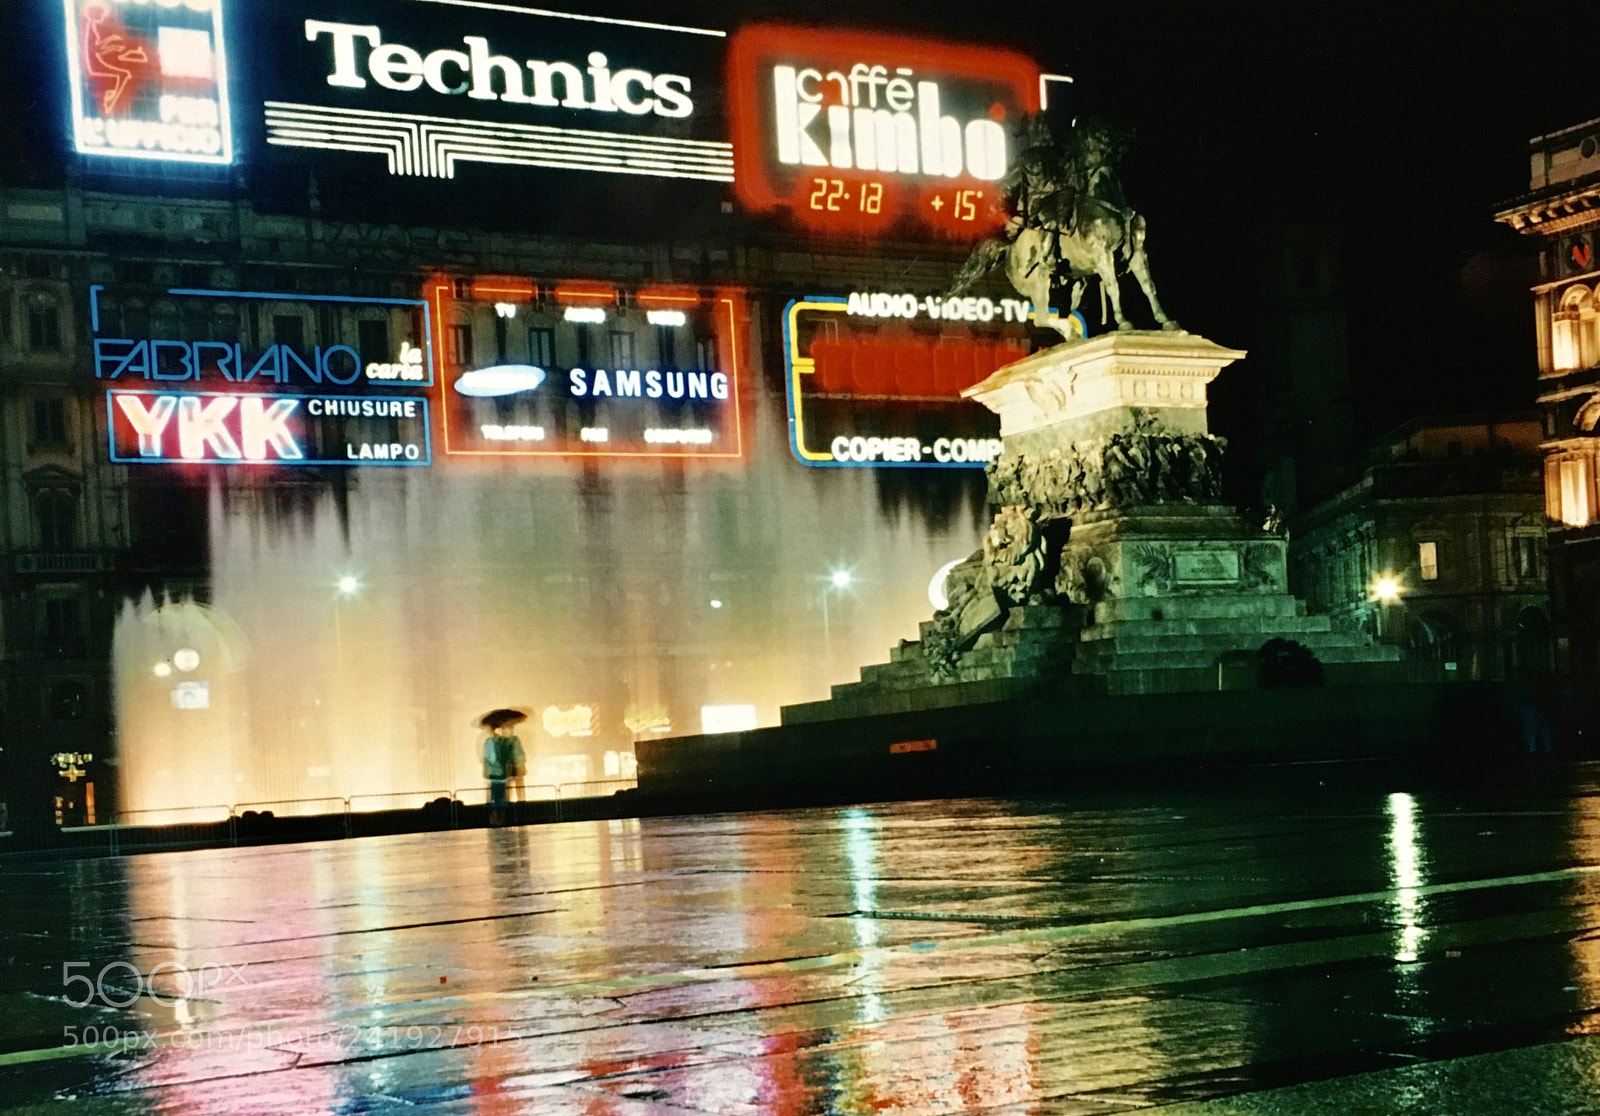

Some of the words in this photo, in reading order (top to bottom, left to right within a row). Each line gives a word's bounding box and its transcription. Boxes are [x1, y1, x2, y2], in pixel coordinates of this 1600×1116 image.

[304, 19, 694, 118] Technics
[774, 64, 1007, 181] kimbo
[94, 339, 361, 385] FABRIANO
[399, 341, 424, 362] la
[570, 368, 729, 399] SAMSUNG
[308, 399, 417, 418] CHIUSURE
[115, 394, 303, 460] YKK
[346, 442, 420, 460] LAMPO
[830, 436, 1004, 462] COPIER-COMP
